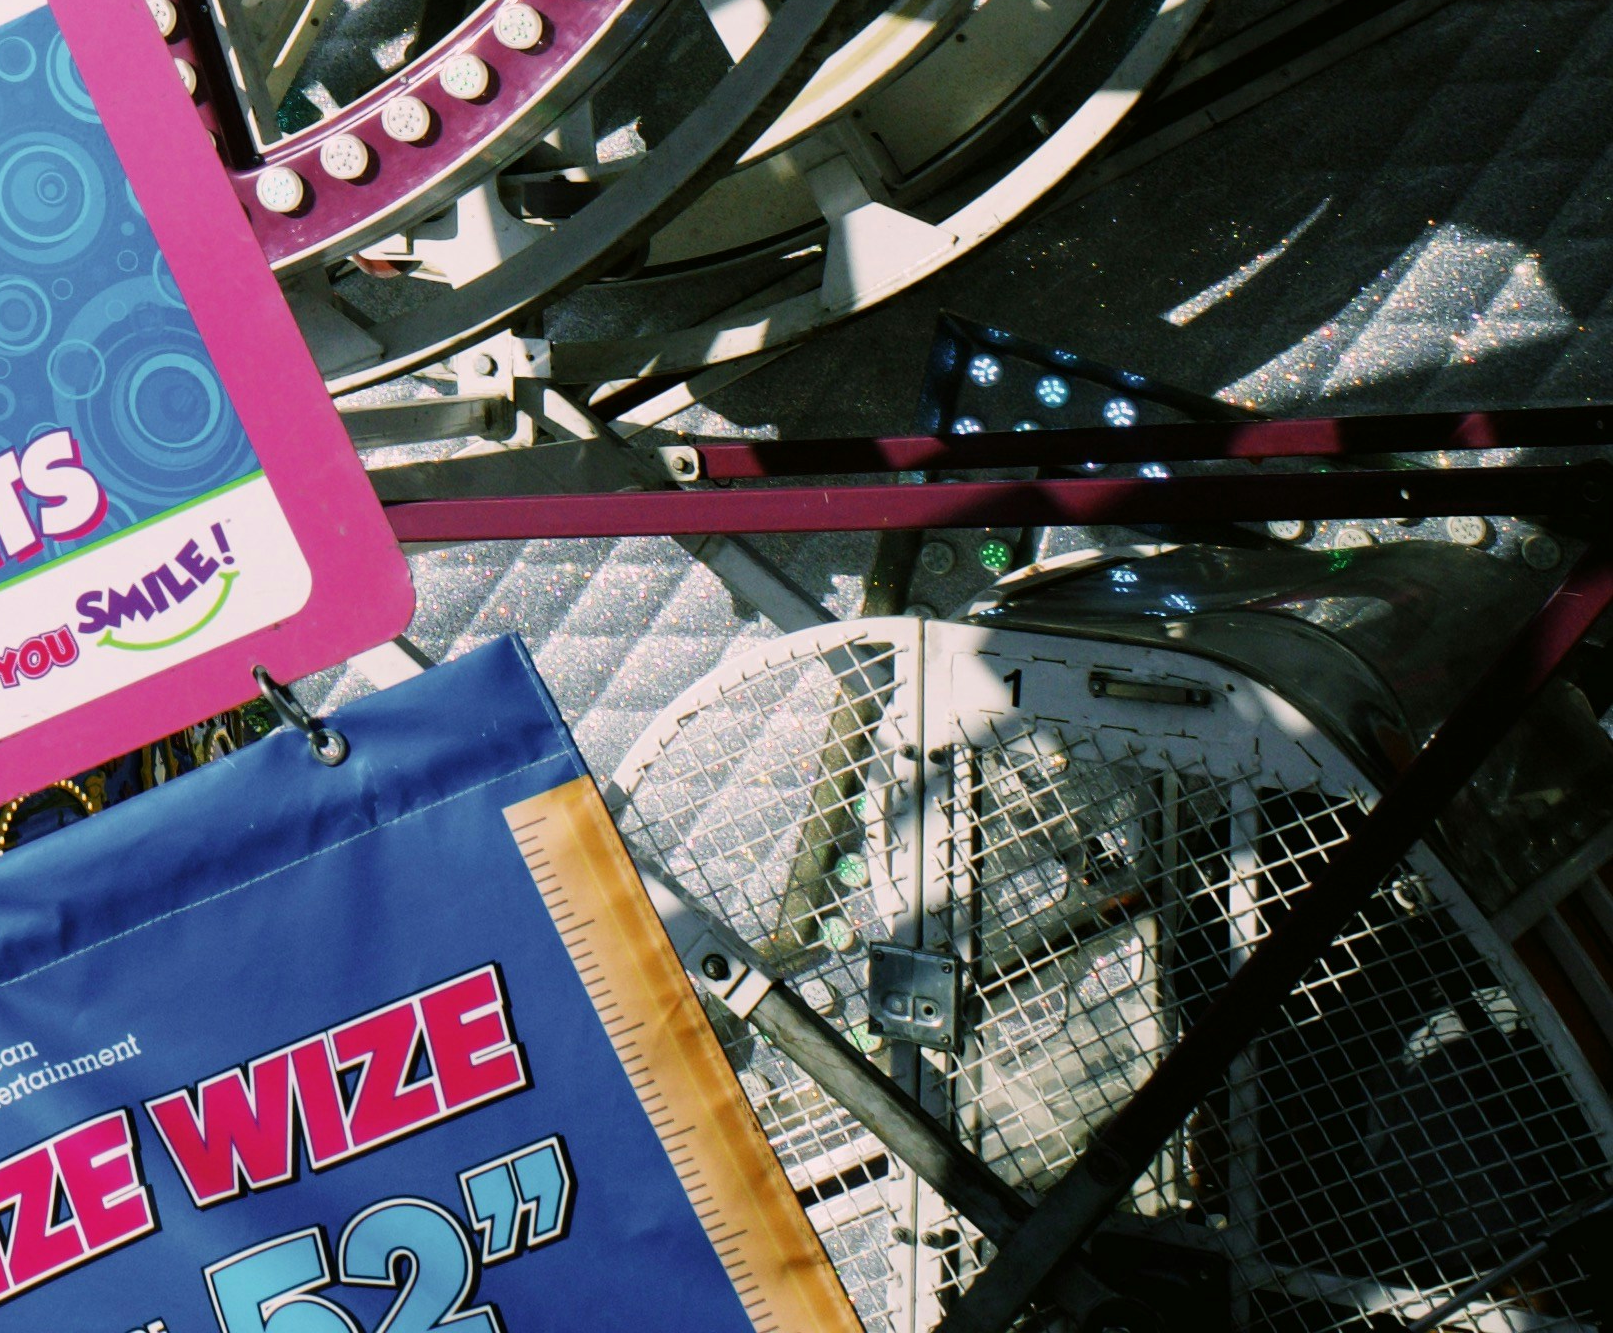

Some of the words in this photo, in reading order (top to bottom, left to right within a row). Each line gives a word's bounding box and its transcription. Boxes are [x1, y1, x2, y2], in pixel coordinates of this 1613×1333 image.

[75, 522, 235, 634] SMILE!
[1003, 668, 1023, 708] 1
[141, 960, 535, 1211] WIZE
